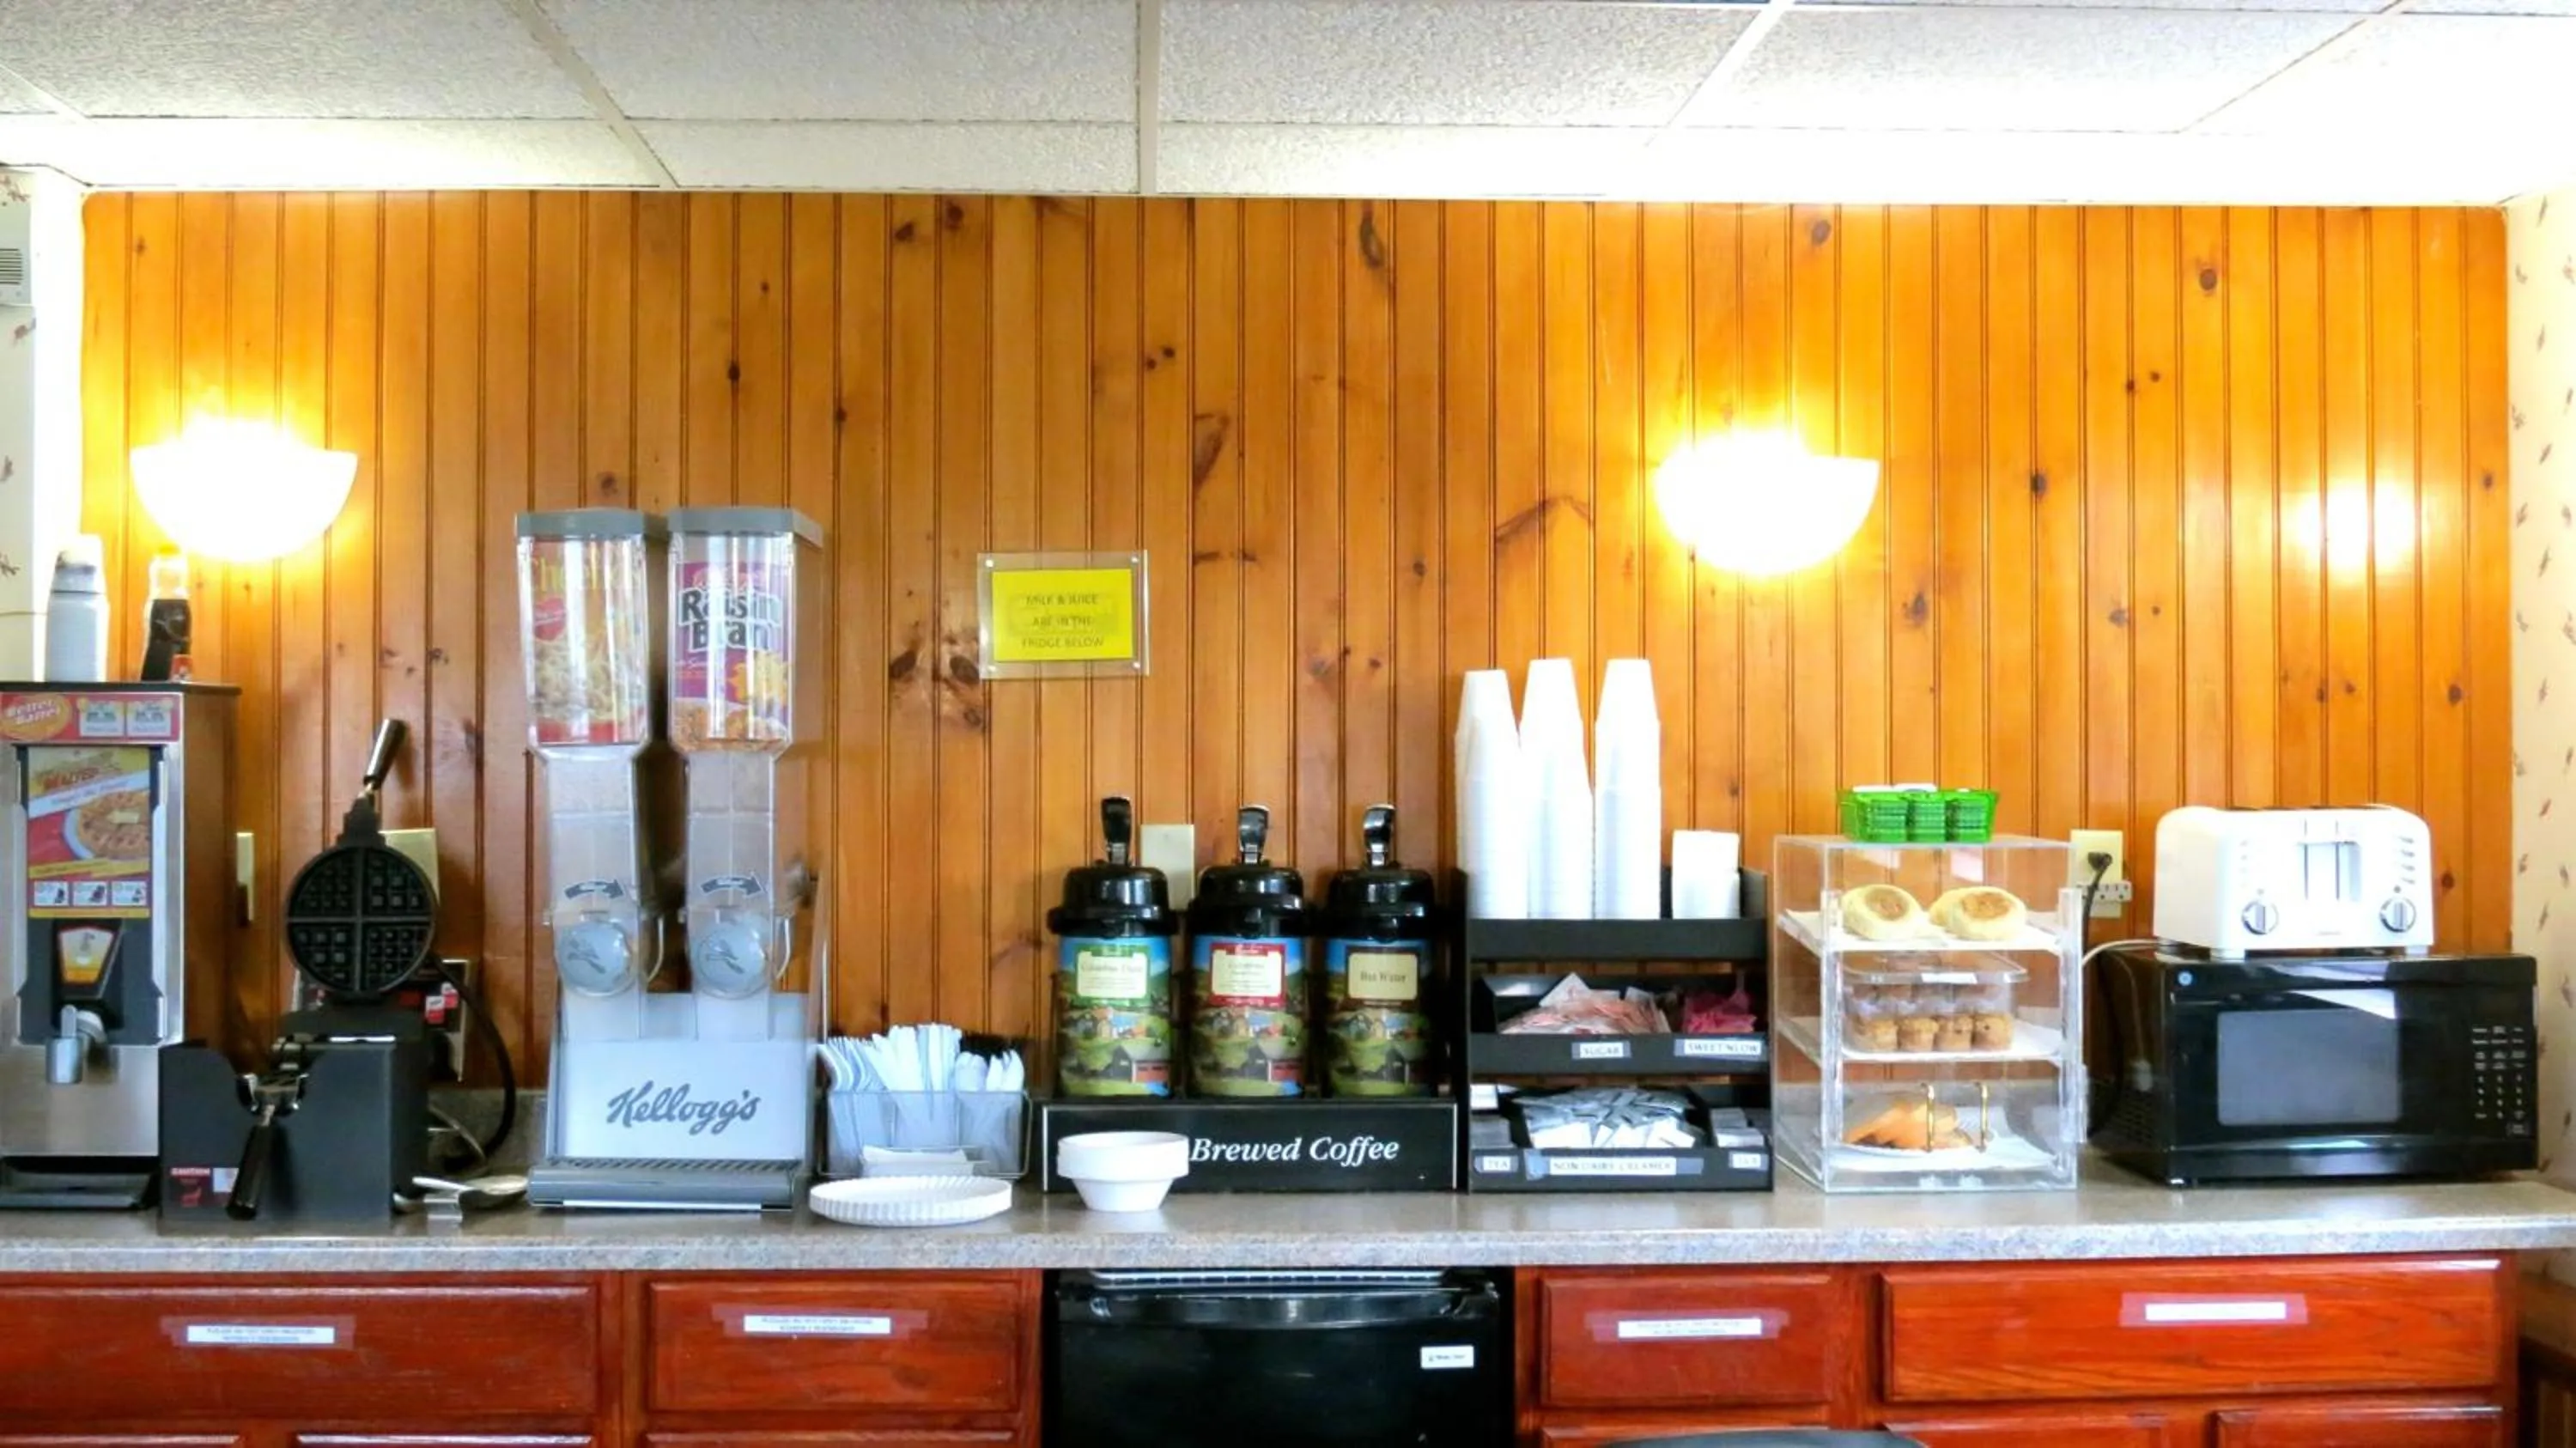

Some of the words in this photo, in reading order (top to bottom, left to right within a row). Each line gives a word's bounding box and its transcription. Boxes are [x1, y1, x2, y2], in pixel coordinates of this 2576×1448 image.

[680, 587, 781, 624] Risin
[1069, 593, 1098, 605] JUICE
[690, 620, 769, 651] Ban
[1032, 616, 1051, 626] ARE
[1022, 636, 1060, 648] FRIDGE
[1065, 636, 1104, 648] BELOW
[605, 1080, 762, 1135] Kellogg's
[1190, 1137, 1303, 1163] Brewed
[1309, 1136, 1400, 1169] Coffee
